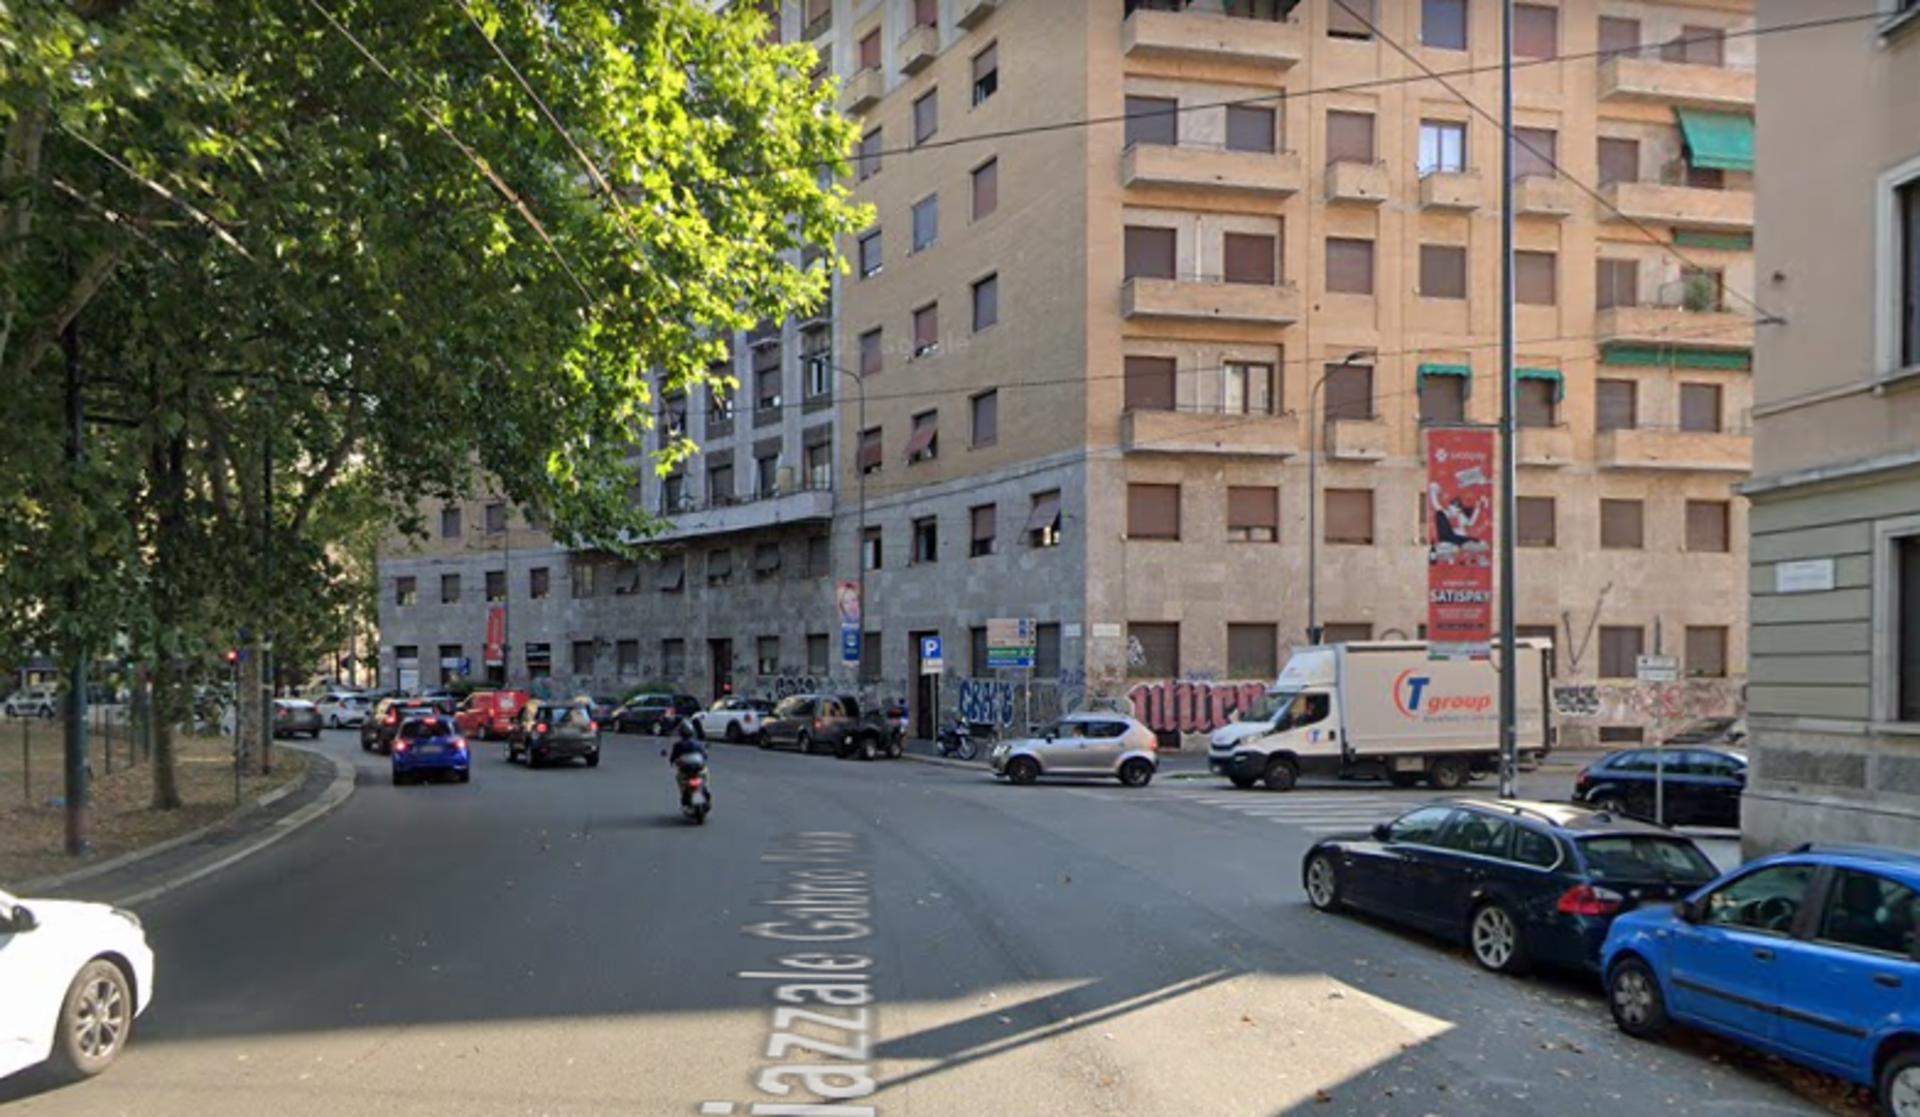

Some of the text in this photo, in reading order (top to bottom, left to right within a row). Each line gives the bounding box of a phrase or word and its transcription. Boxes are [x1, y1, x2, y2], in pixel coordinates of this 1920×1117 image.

[1430, 588, 1490, 603] SATISPAY
[925, 639, 939, 657] P
[1407, 677, 1492, 714] T group
